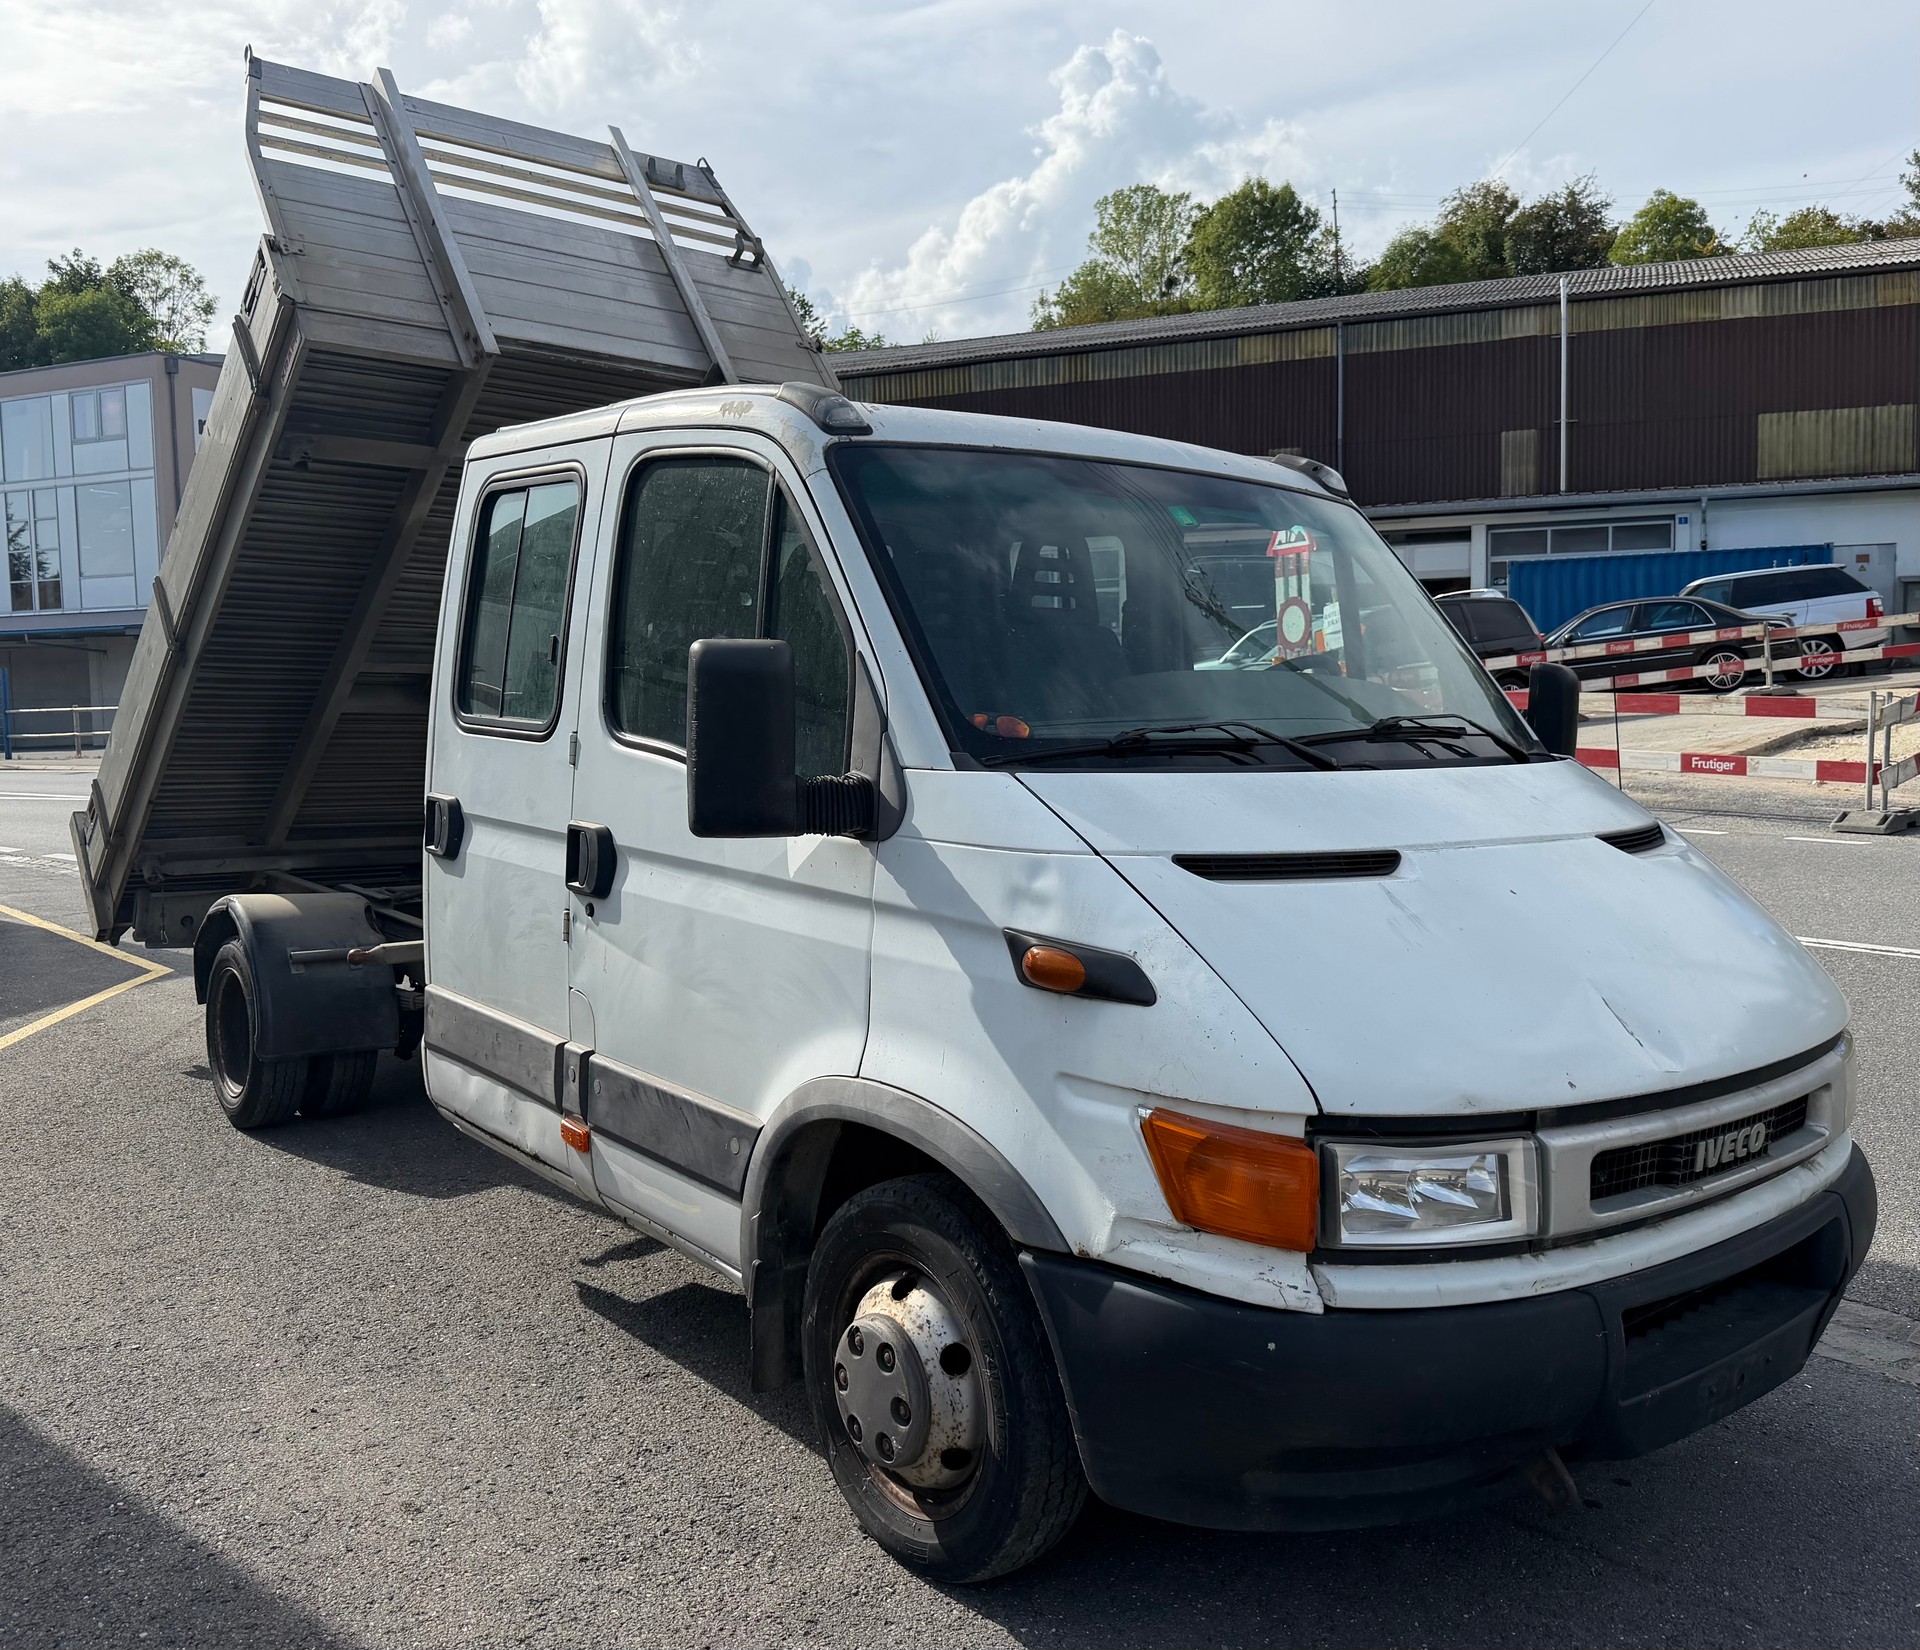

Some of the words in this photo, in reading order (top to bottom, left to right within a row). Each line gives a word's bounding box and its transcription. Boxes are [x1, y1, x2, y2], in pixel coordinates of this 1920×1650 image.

[1843, 621, 1871, 631] Frutiger
[1521, 653, 1542, 664] Frutiger
[1807, 656, 1835, 665] Frutiger
[1691, 756, 1735, 772] Frutiger
[1694, 1122, 1766, 1173] IVECO
